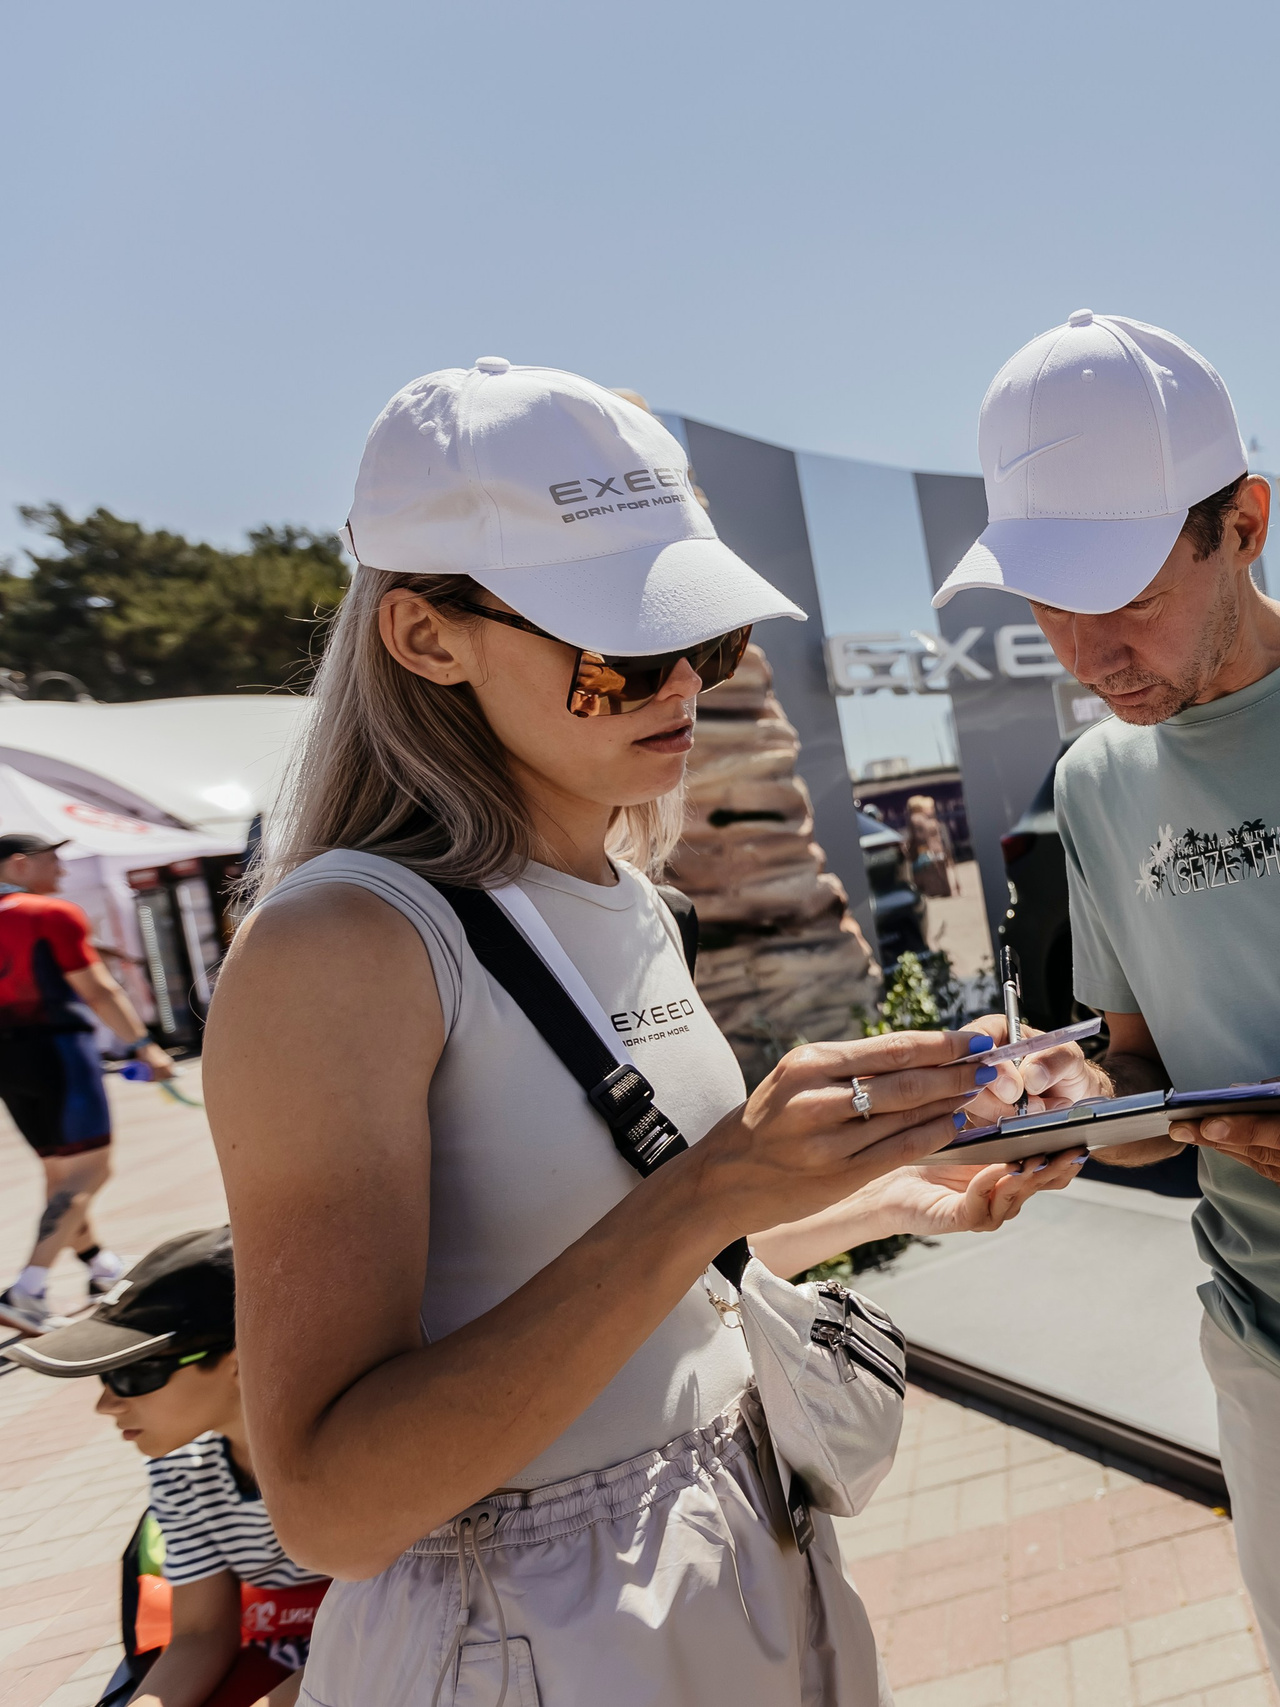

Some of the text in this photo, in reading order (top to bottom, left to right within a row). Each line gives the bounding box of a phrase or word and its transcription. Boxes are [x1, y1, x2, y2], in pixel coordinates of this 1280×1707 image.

[561, 494, 686, 524] BORN FOR MORE
[1208, 840, 1216, 850] AT
[1220, 834, 1240, 847] EASE
[1242, 829, 1265, 841] WITH
[1176, 848, 1240, 894] SEIZE
[610, 999, 694, 1032] EXEED
[648, 1030, 666, 1041] FOR
[667, 1025, 690, 1036] MORE
